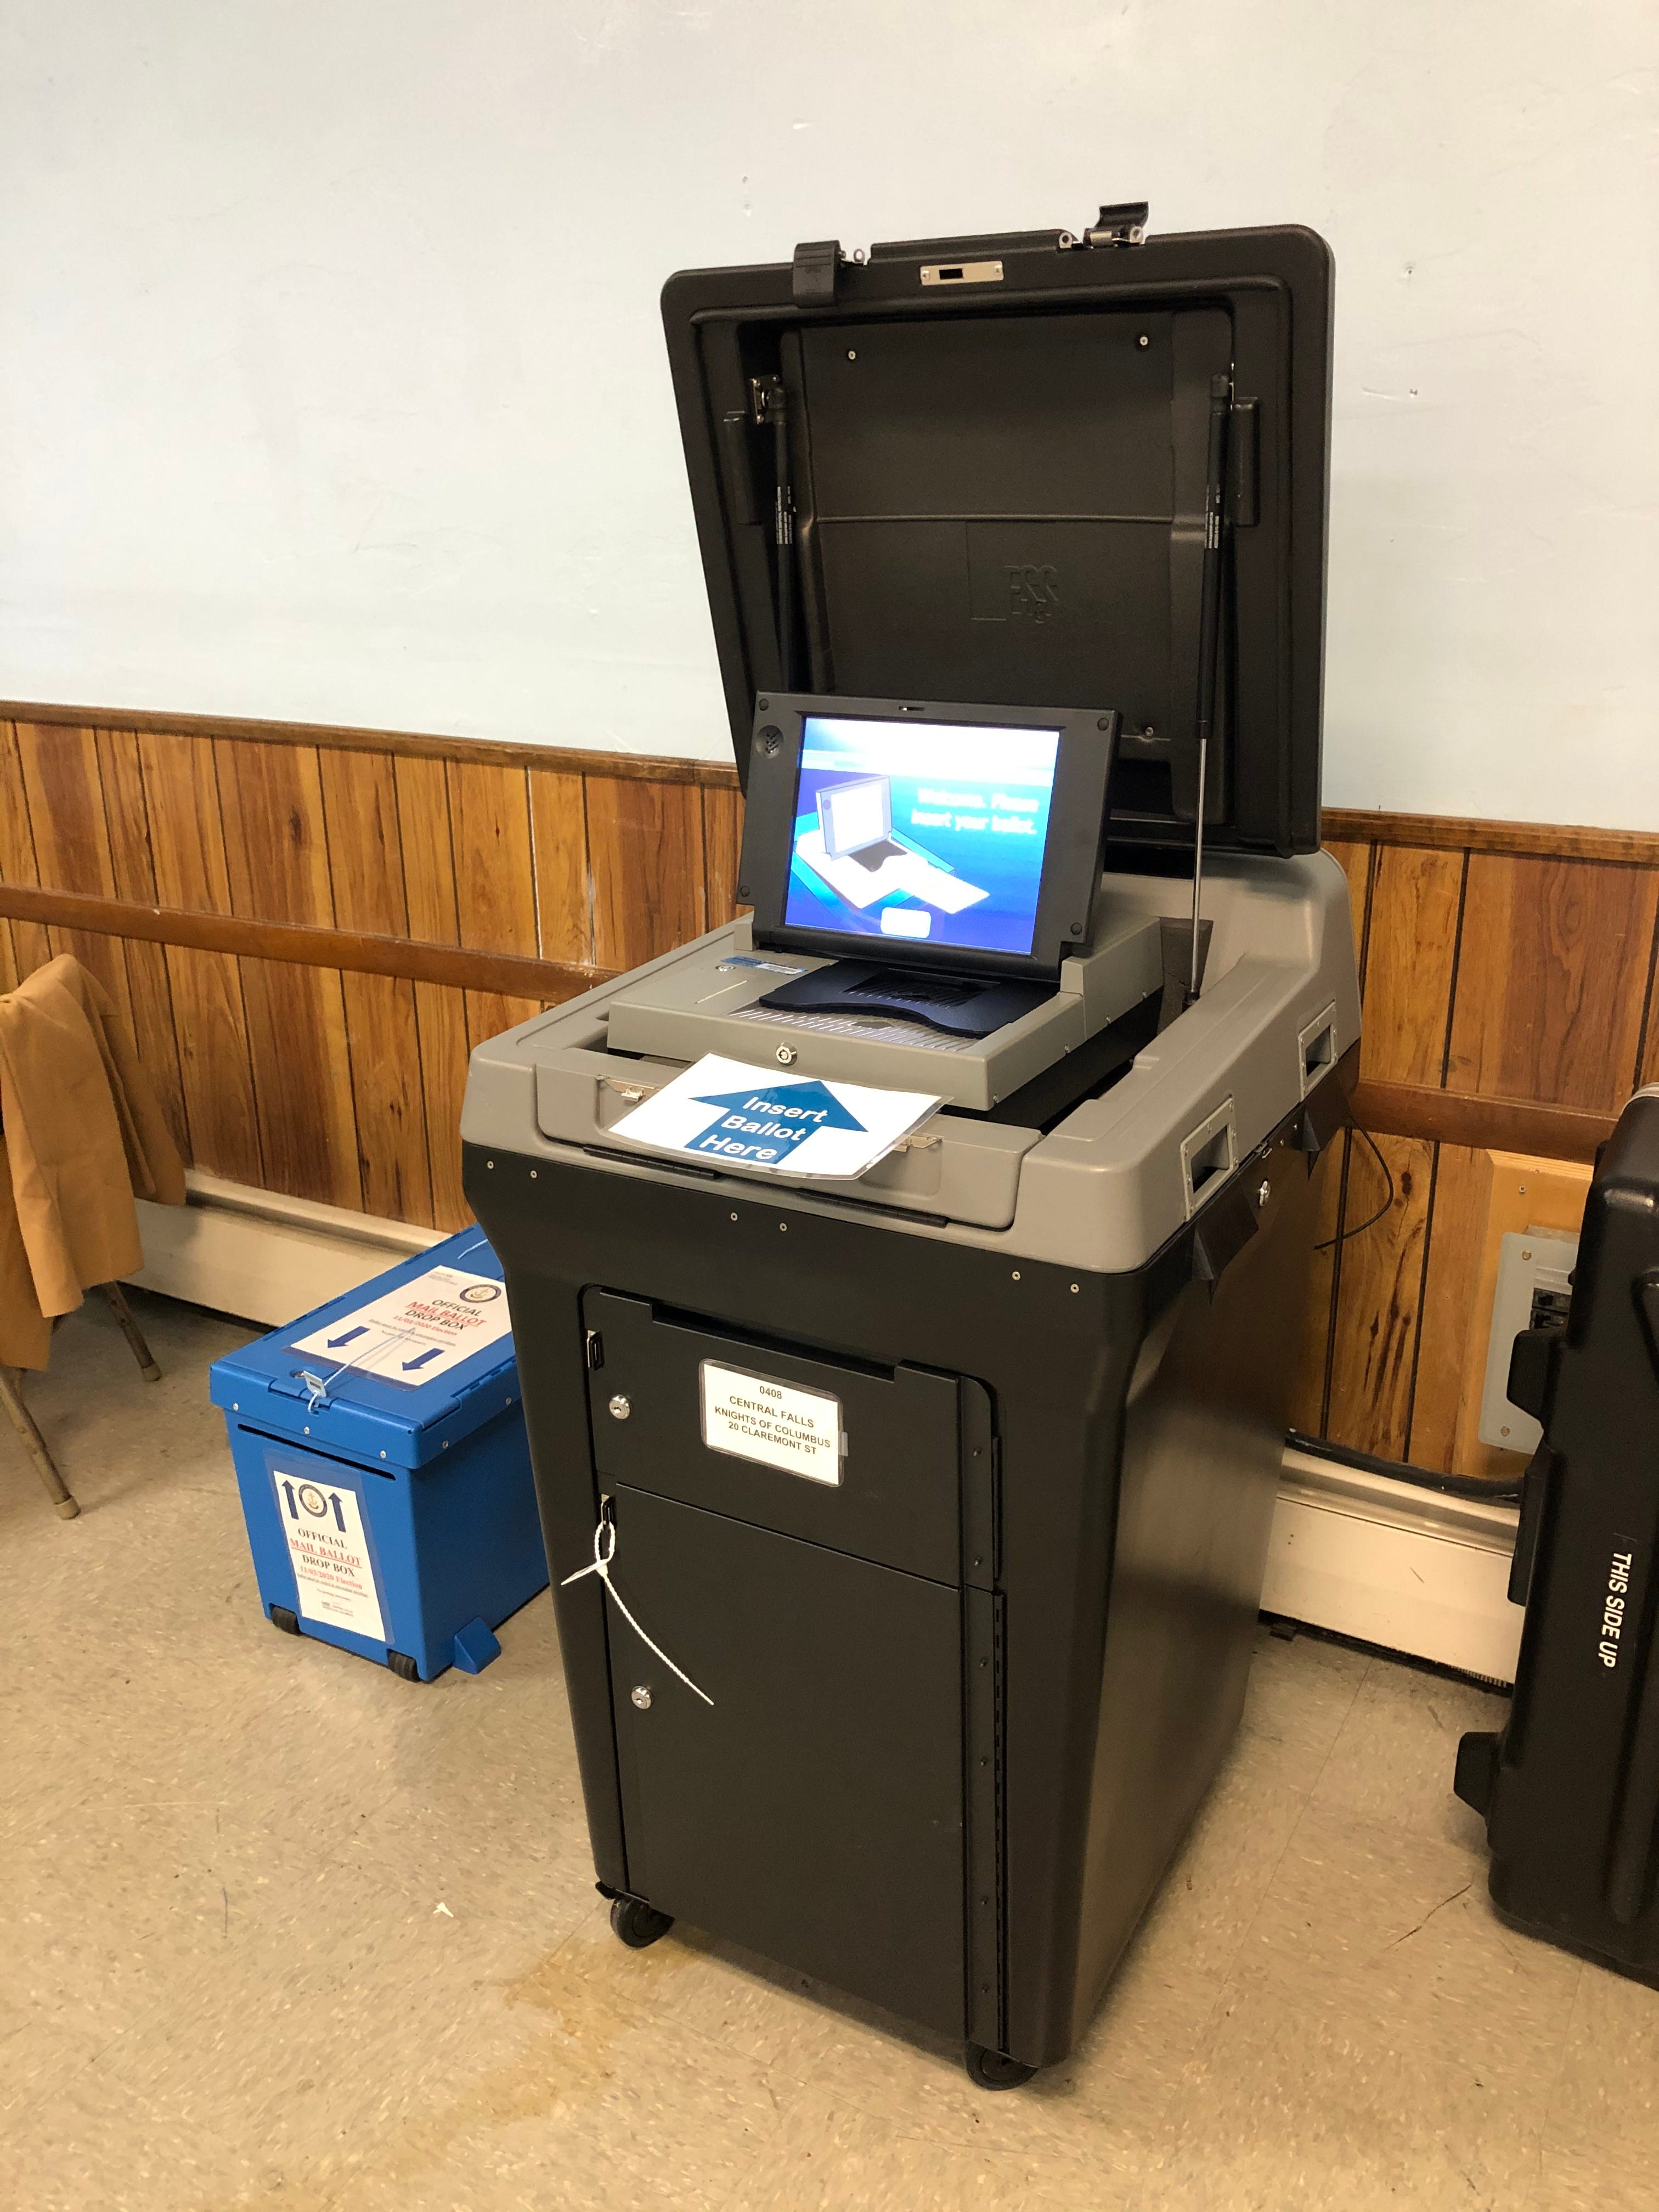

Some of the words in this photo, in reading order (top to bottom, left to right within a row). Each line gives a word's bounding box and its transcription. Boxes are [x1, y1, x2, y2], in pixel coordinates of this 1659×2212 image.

[742, 1097, 828, 1123] Insert
[721, 1115, 806, 1142] Ballot
[699, 1134, 778, 1160] Here
[405, 1310, 440, 1322] DROP
[439, 1319, 468, 1330] BOX
[409, 1301, 439, 1314] MAIL
[439, 1310, 487, 1325] BALLOT
[432, 1300, 482, 1316] OFFICIAL
[759, 1386, 782, 1399] 0408
[730, 1396, 777, 1417] CENTRAL
[781, 1411, 814, 1427] FALLS
[715, 1406, 757, 1425] KNIGHTS
[759, 1420, 772, 1429] OF
[775, 1425, 831, 1448] COLUMBUS
[729, 1421, 738, 1430] 20
[742, 1426, 802, 1450] CLAREMONT
[805, 1445, 816, 1454] ST
[298, 1527, 347, 1549] OFFICIAL
[290, 1538, 318, 1554] MAIL
[320, 1545, 362, 1566] BALLOT
[303, 1555, 330, 1570] DROP
[334, 1564, 354, 1577] BOX
[1609, 1553, 1632, 1593] THIS
[336, 1576, 363, 1589] Election
[1602, 1595, 1625, 1639] SIDE
[1598, 1641, 1618, 1667] UP
